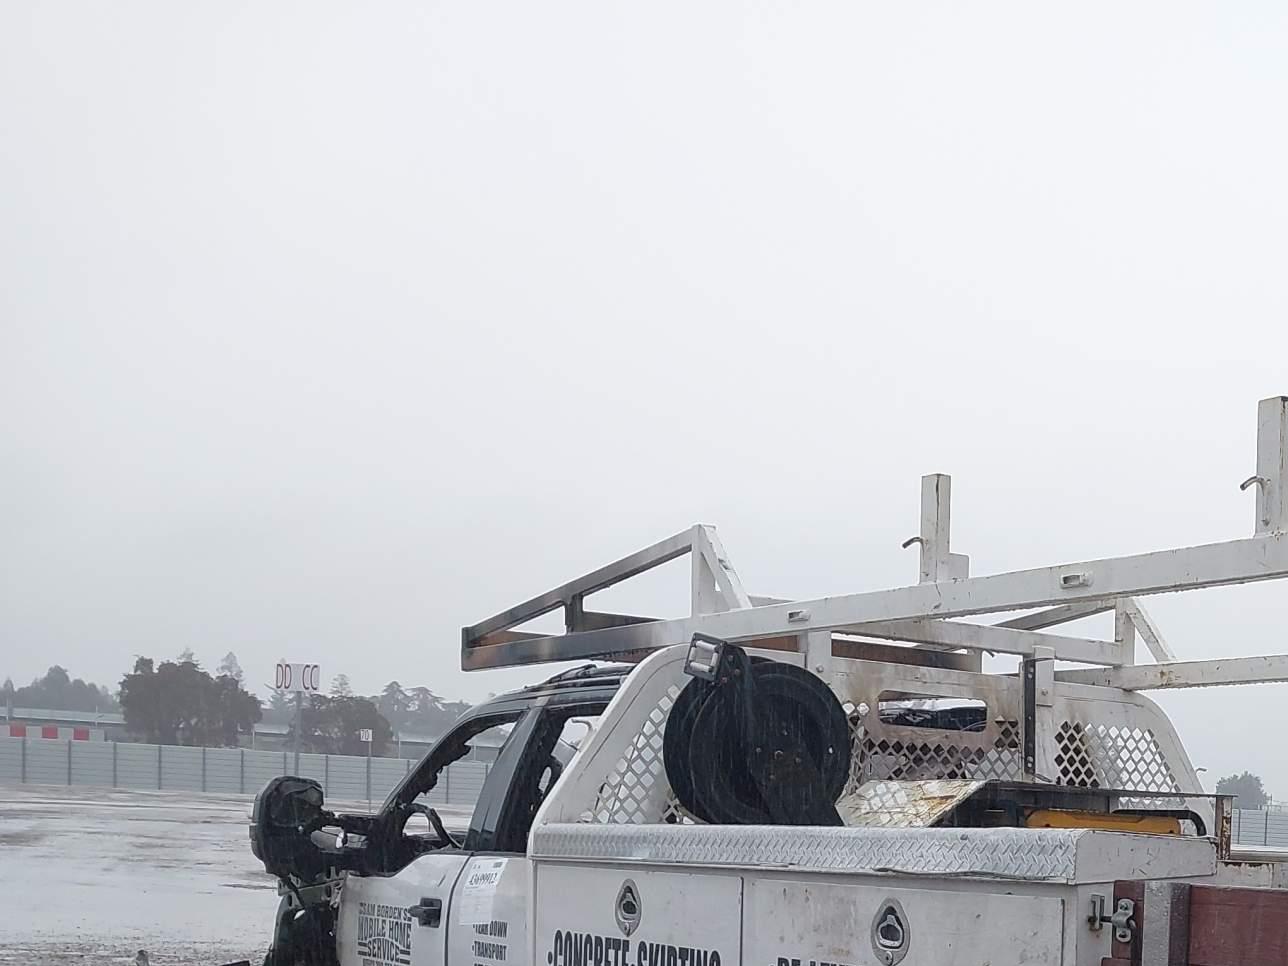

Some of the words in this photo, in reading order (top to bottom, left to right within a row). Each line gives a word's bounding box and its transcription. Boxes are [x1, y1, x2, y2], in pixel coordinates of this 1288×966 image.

[276, 664, 291, 689] DD
[302, 664, 318, 690] CC
[358, 916, 386, 940] MOBILE
[389, 919, 411, 949] HOME
[490, 920, 508, 938] DOWN
[367, 938, 400, 962] SERVICE
[474, 941, 507, 960] TRANSPORT
